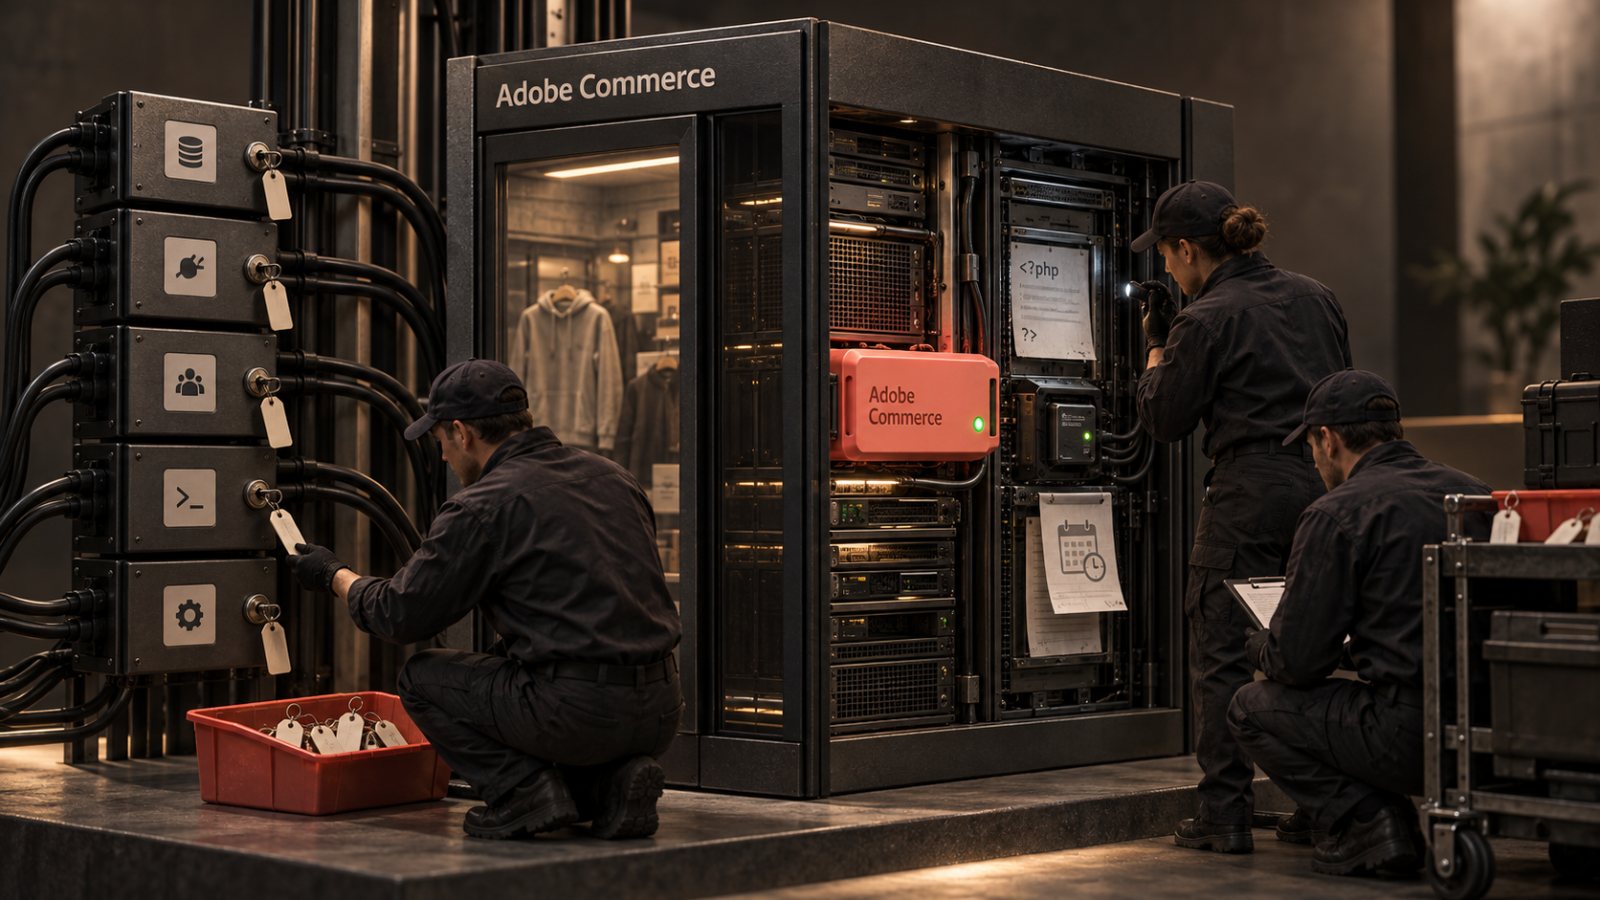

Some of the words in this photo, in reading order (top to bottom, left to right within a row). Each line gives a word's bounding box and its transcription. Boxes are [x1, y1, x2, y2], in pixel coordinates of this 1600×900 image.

[495, 78, 573, 108] Adobe
[579, 67, 716, 99] Commerce
[1019, 260, 1059, 281] <?php
[869, 386, 915, 404] Adobe
[868, 407, 943, 426] Commerce
